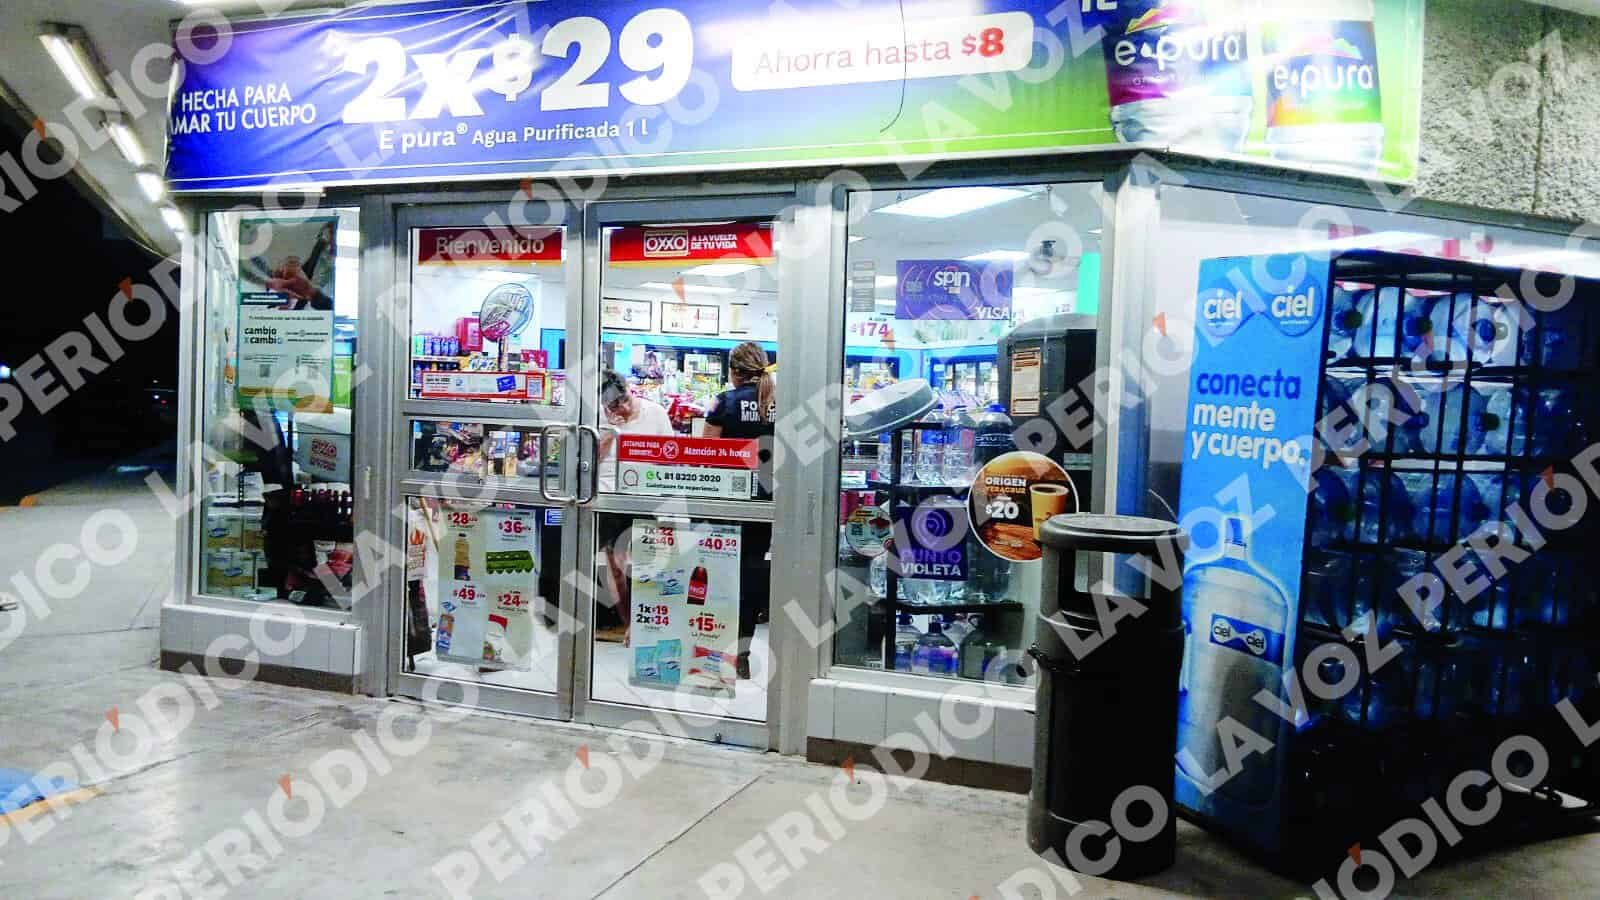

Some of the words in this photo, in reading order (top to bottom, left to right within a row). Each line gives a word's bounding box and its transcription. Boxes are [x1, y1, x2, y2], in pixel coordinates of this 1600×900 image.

[753, 46, 854, 75] Ahorra
[865, 36, 952, 65] hasta
[961, 27, 1005, 58] $8
[182, 88, 239, 112] HECHA
[244, 82, 292, 106] PARA
[216, 111, 236, 132] TU
[242, 103, 317, 130] CUERPO
[380, 129, 394, 150] E
[472, 128, 517, 146] Agua
[523, 121, 620, 142] Purificada
[625, 121, 635, 137] 1
[435, 235, 545, 255] Bienvenido
[646, 236, 687, 251] OXXO
[691, 242, 703, 250] DE
[703, 242, 715, 250] TU
[714, 241, 737, 249] VIDA
[934, 271, 970, 288] spin
[1203, 290, 1242, 320] ciel
[1272, 286, 1315, 318] ciel
[976, 307, 1009, 319] VISA
[244, 325, 277, 336] cambio
[1196, 369, 1302, 400] conecta
[1193, 401, 1275, 431] mente
[684, 447, 716, 457] Atención
[718, 448, 728, 457] 24
[730, 449, 751, 458] horas
[1192, 431, 1207, 459] y
[1208, 432, 1306, 469] cuerpo.
[699, 474, 721, 482] 2020
[985, 477, 1026, 487] ORIGEN
[985, 500, 1019, 519] $20
[448, 513, 469, 525] $28
[498, 521, 522, 533] $36
[901, 550, 961, 564] PUNTO
[901, 563, 961, 576] VIOLETA
[453, 589, 475, 600] $49
[498, 594, 520, 607] $24
[689, 617, 714, 631] $15
[1213, 623, 1231, 638] ciel
[1246, 632, 1264, 649] ciel
